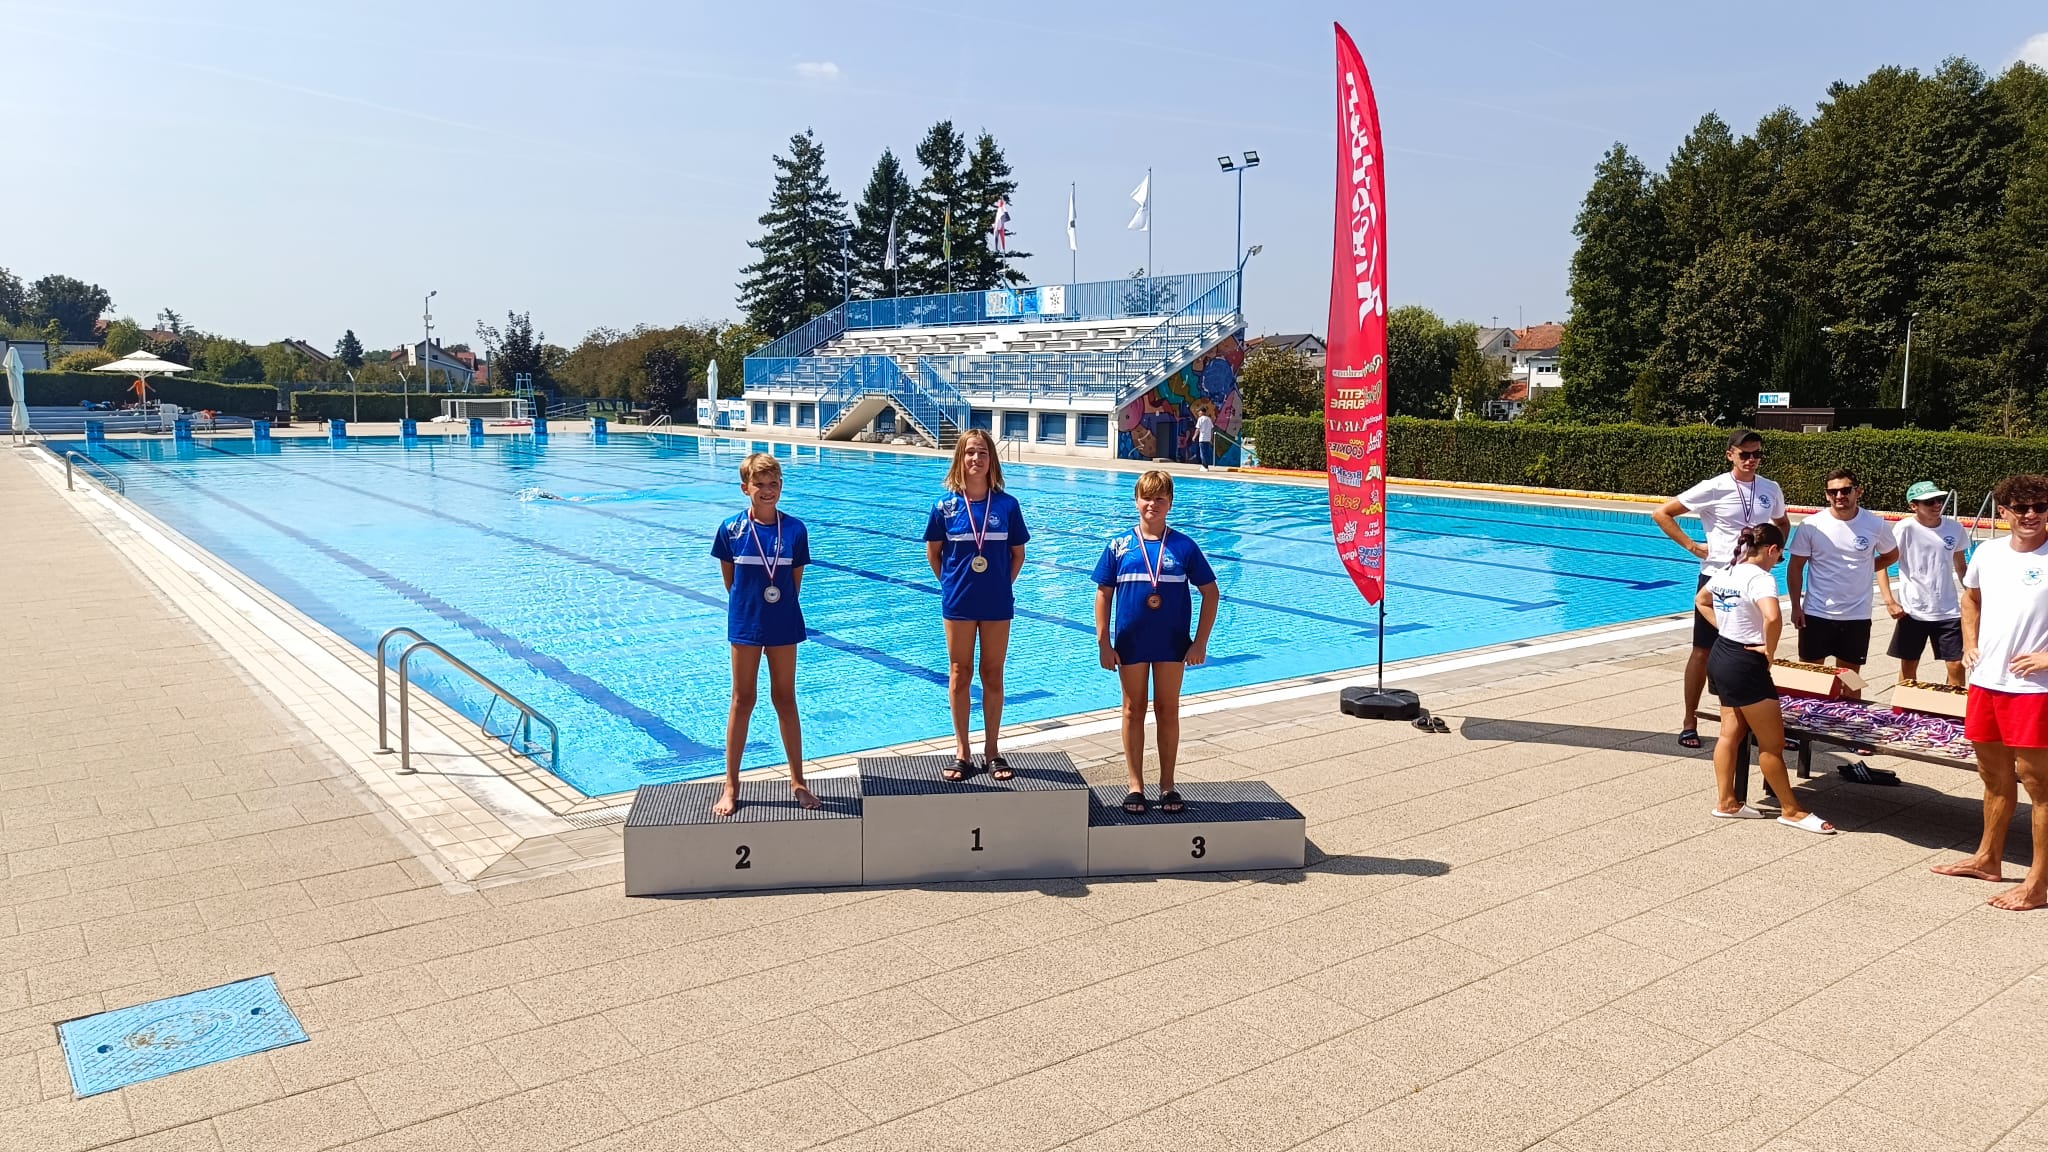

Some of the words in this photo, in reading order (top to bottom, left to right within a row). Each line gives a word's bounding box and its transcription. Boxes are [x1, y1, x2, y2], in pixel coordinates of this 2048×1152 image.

[970, 828, 984, 852] 1
[1191, 836, 1207, 859] 3
[734, 845, 751, 870] 2
